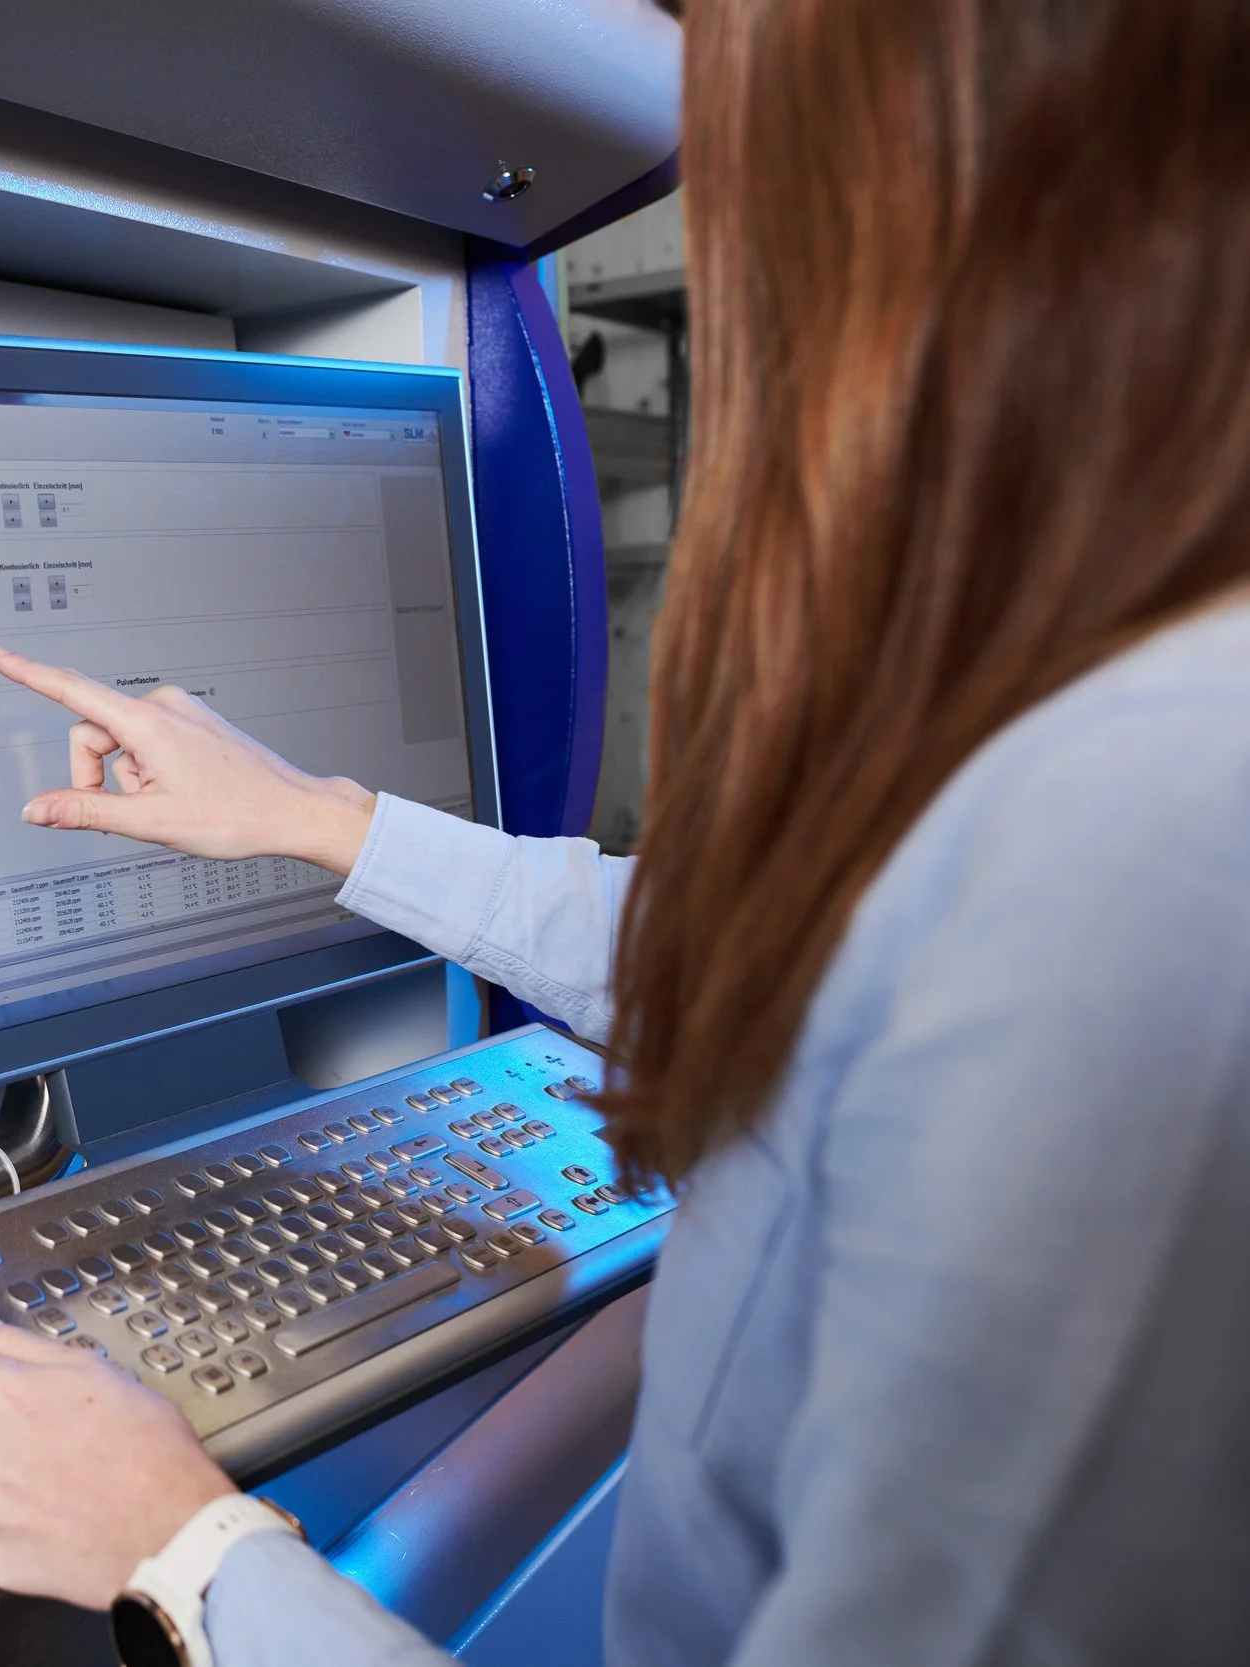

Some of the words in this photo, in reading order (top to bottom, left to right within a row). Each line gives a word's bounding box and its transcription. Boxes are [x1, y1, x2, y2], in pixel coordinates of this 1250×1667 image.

[403, 428, 424, 439] SLM
[33, 482, 67, 490] Einzelschritt
[0, 563, 40, 571] Kontinuierlich
[43, 561, 77, 569] Einzelschritt
[116, 676, 160, 686] Pulverflaschen
